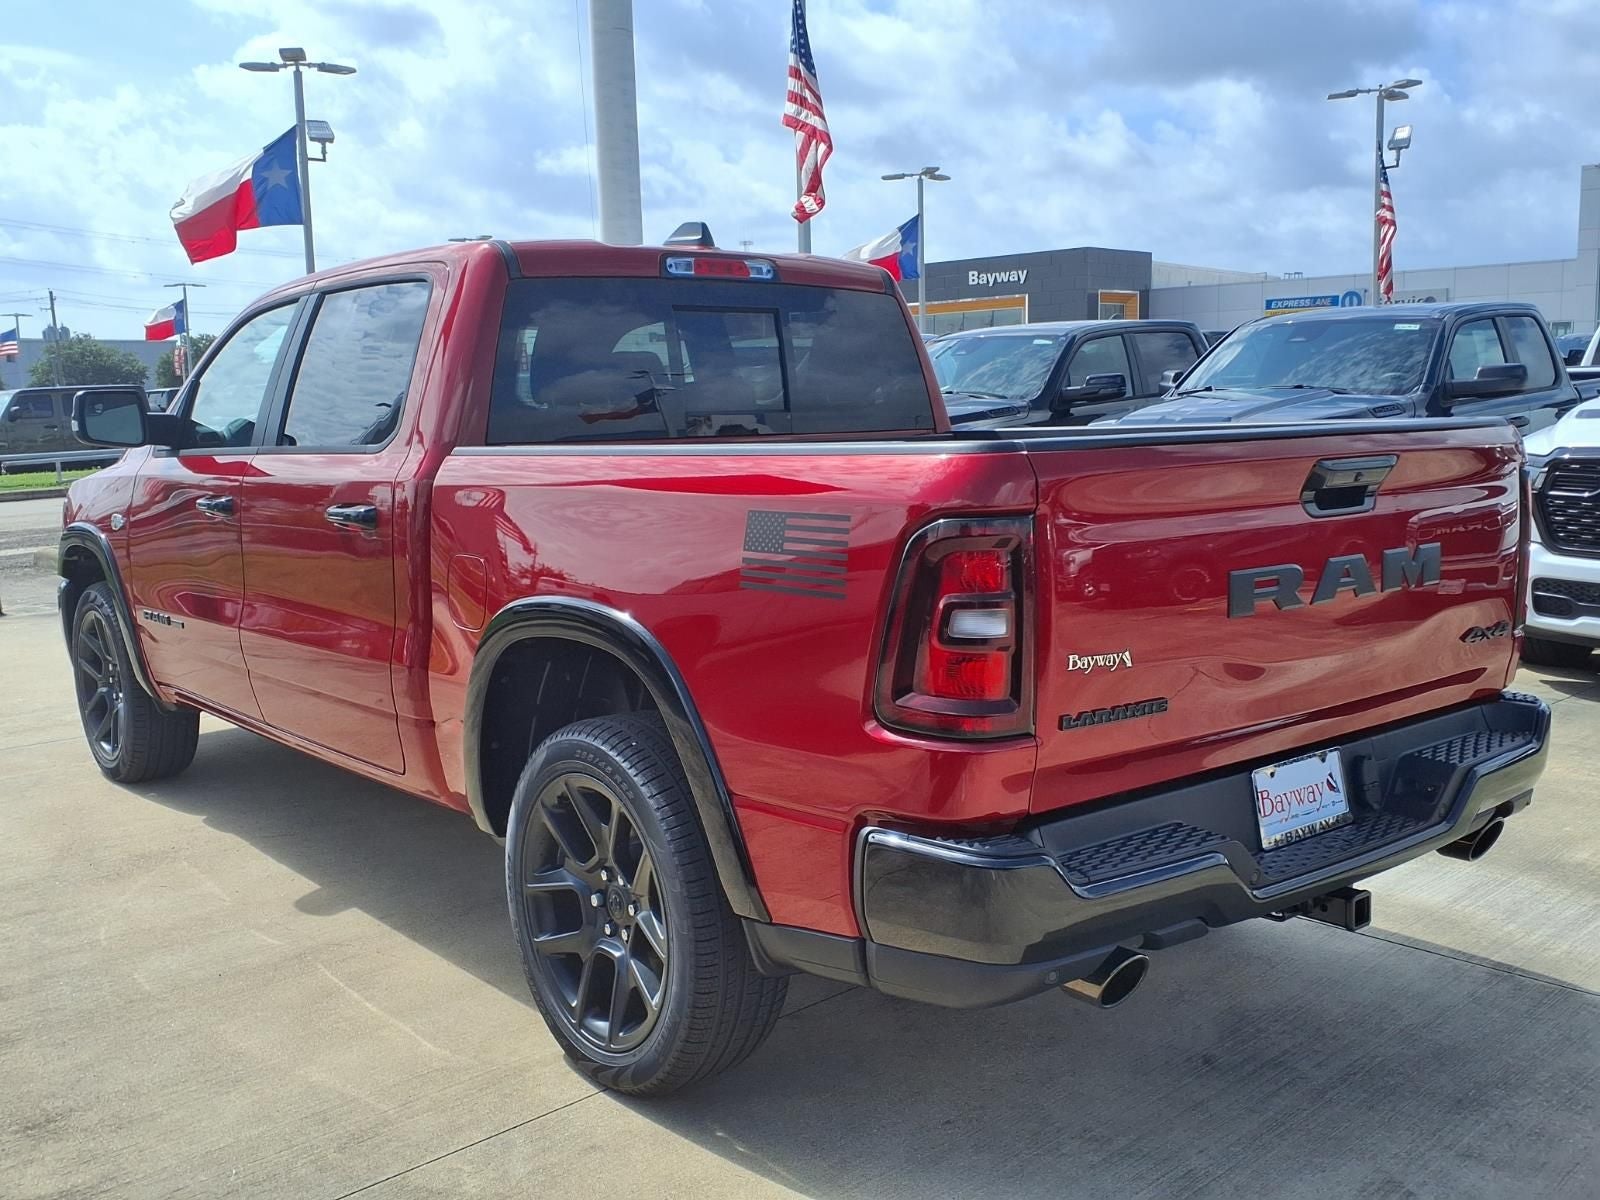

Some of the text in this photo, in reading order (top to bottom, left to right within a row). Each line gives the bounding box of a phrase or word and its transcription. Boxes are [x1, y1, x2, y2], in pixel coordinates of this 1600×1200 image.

[968, 269, 1028, 287] Bayway
[1227, 541, 1440, 618] RAM
[1067, 651, 1122, 674] Bayway
[1058, 696, 1168, 732] LARAMIE
[1258, 781, 1325, 823] Bayway
[1284, 817, 1332, 843] BAYWAY
